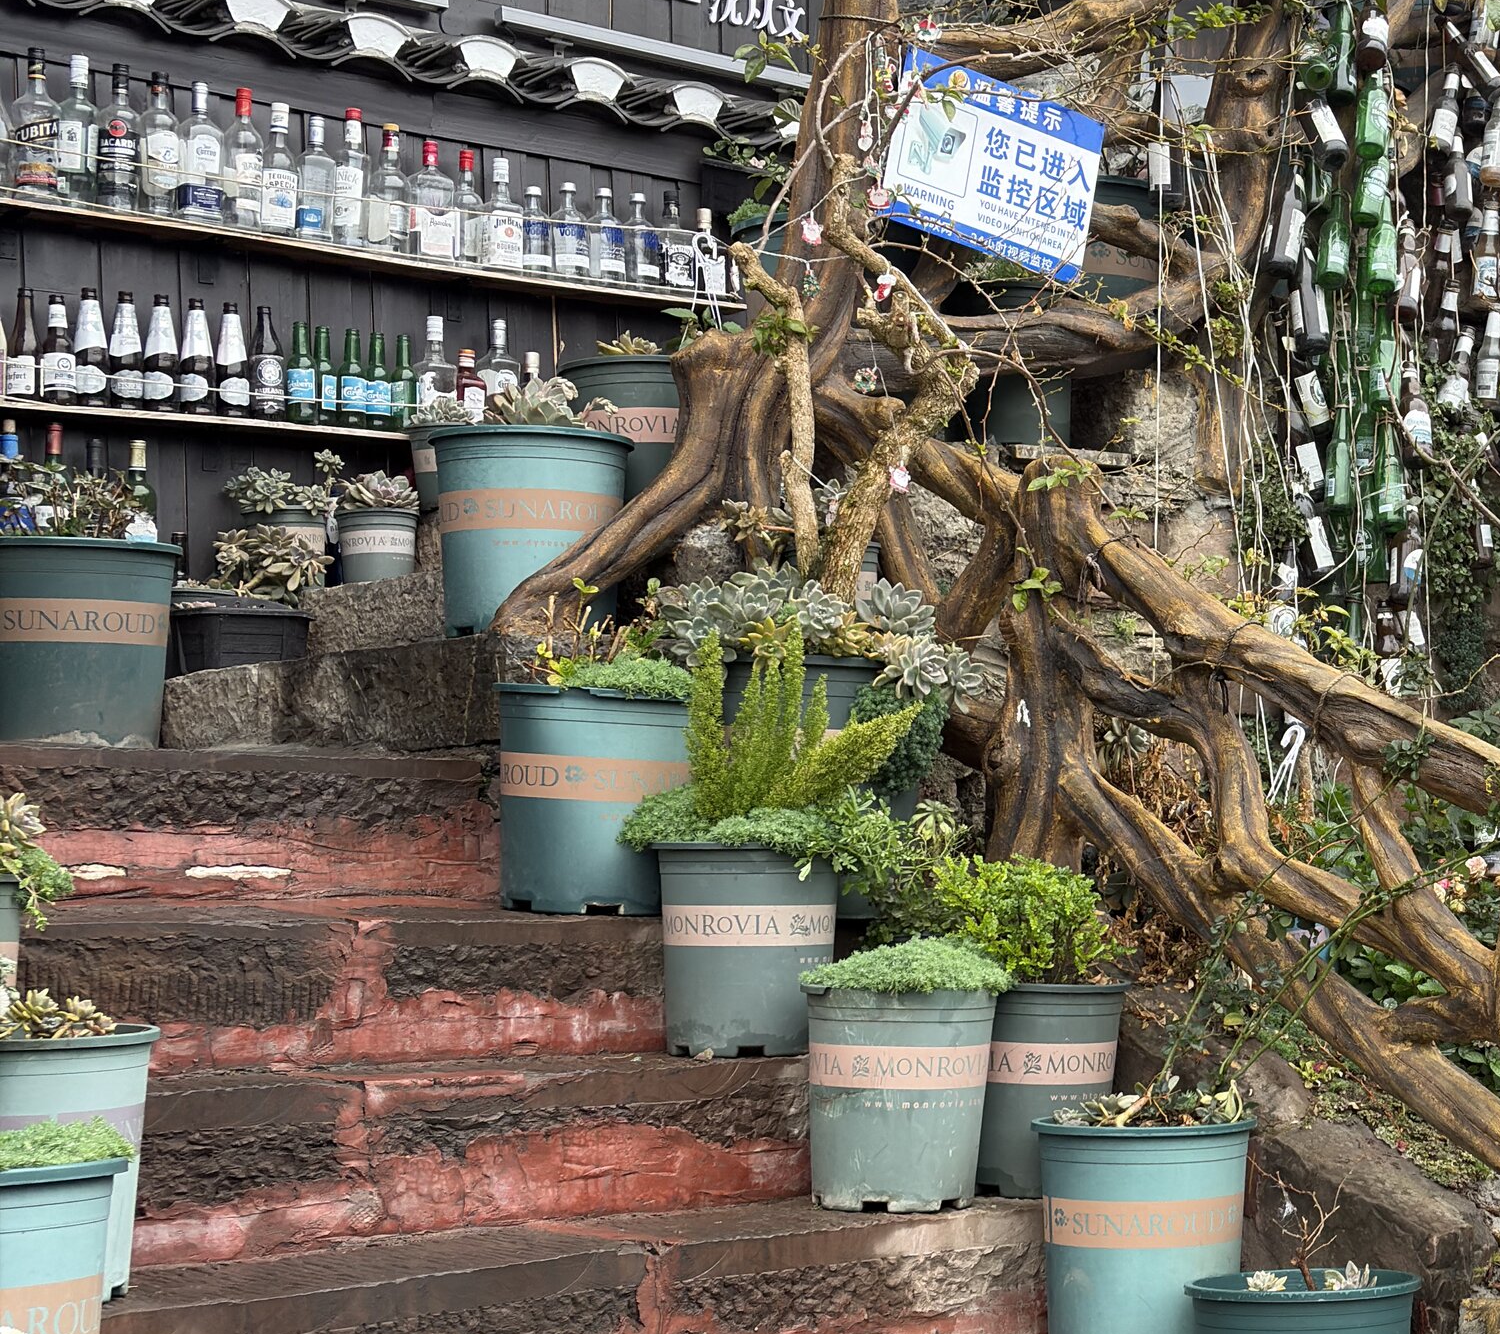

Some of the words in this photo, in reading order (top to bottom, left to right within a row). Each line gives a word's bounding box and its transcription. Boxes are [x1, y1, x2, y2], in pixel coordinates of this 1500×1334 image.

[972, 78, 1062, 131] 温馨提示
[984, 126, 1091, 193] 您已进入
[903, 183, 955, 211] WARNING
[977, 165, 1087, 231] 监控区域
[977, 212, 1002, 229] VIDEO
[1003, 221, 1042, 243] MONITOR
[1042, 236, 1063, 251] AREA
[980, 198, 997, 211] YOU
[1000, 205, 1019, 220] HAVE
[1019, 213, 1056, 234] ENTERED
[1057, 227, 1077, 241] INTO
[3, 609, 155, 634] SUNAROUD
[664, 914, 781, 936] MONROVIA
[1072, 1208, 1225, 1237] SUNAROUD
